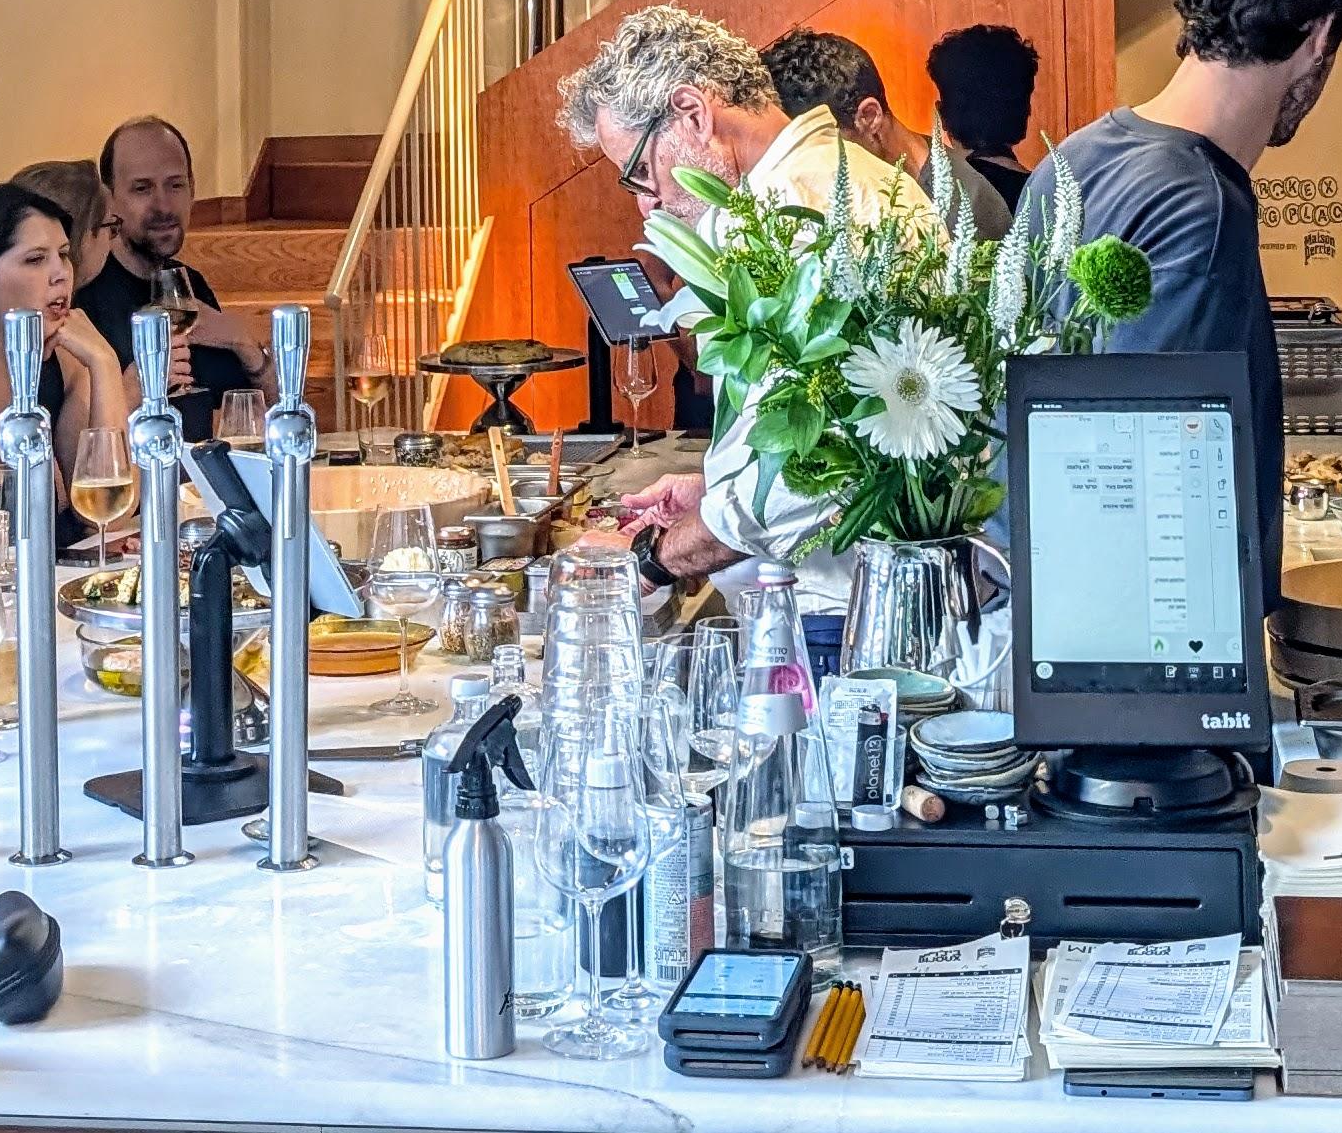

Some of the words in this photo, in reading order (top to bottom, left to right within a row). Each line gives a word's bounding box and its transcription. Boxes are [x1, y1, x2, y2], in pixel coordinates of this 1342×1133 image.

[1304, 230, 1336, 247] Maison
[1201, 712, 1251, 729] tabit
[866, 739, 882, 799] planet13
